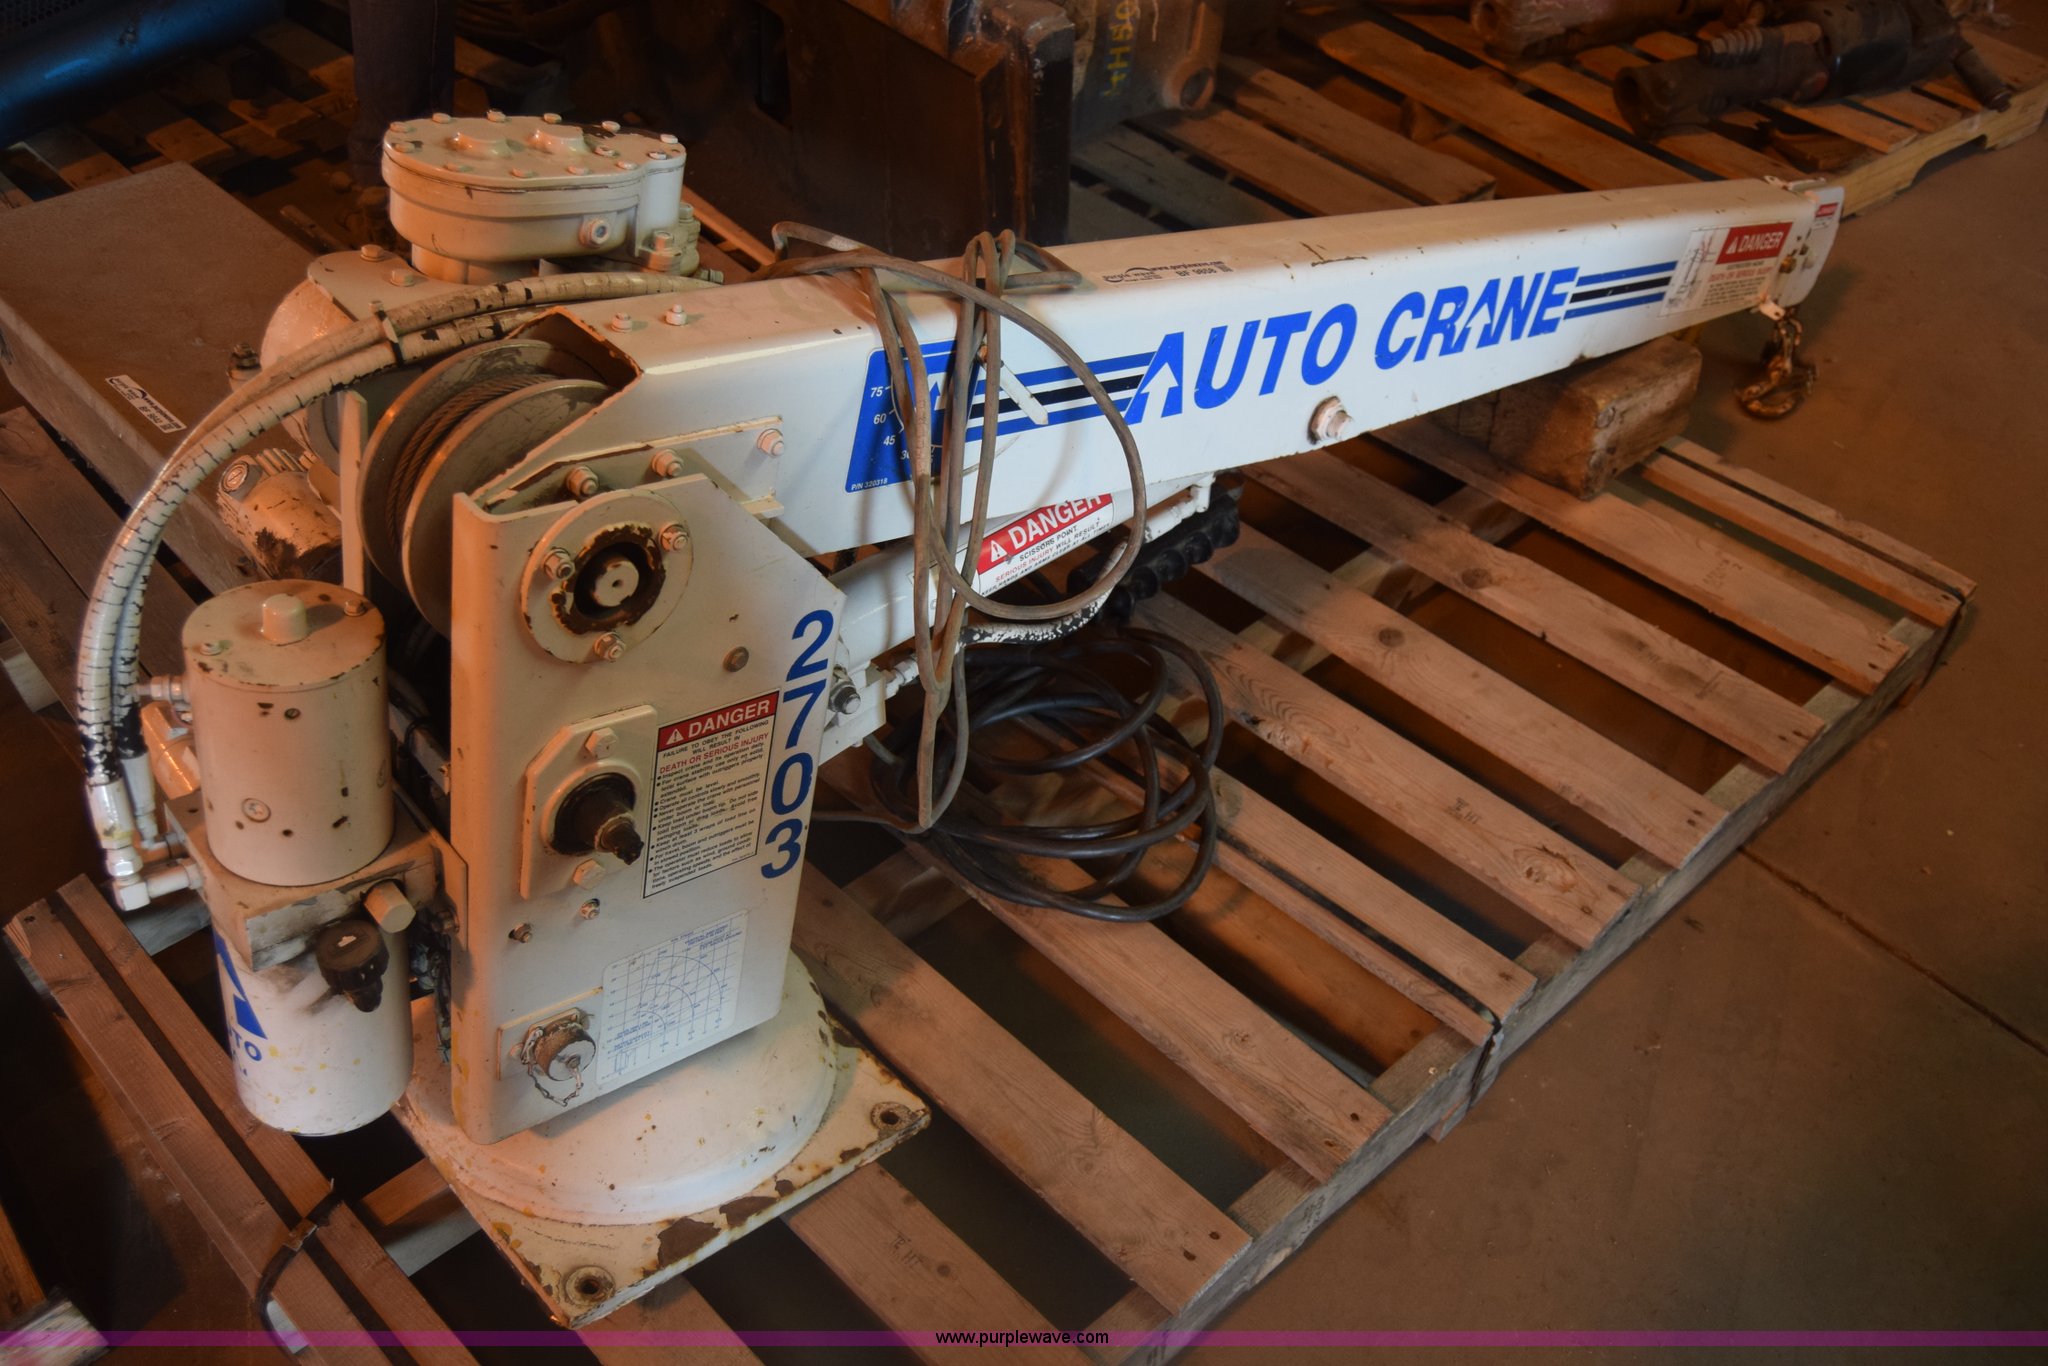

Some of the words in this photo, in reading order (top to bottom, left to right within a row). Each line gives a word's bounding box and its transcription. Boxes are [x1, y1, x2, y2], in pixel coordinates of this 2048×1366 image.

[1738, 232, 1784, 252] DANGER
[1124, 303, 1358, 425] AUTO
[1375, 265, 1580, 371] CRANE
[870, 386, 883, 398] 75
[873, 413, 886, 424] 60
[883, 435, 896, 446] 45
[995, 563, 1027, 582] SERIOUS
[1029, 548, 1053, 565] INJURY
[1056, 538, 1071, 550] WILL
[1074, 522, 1100, 539] RESULT
[1020, 537, 1055, 561] SCISSORS
[1057, 525, 1078, 541] POINT
[688, 698, 770, 738] DANGER
[659, 759, 687, 774] DEATH
[689, 754, 701, 764] OR
[703, 741, 739, 759] SERIOUS
[740, 731, 768, 747] INJURY
[692, 746, 705, 754] WILL
[709, 737, 731, 749] RESULT
[761, 610, 834, 879] 2703
